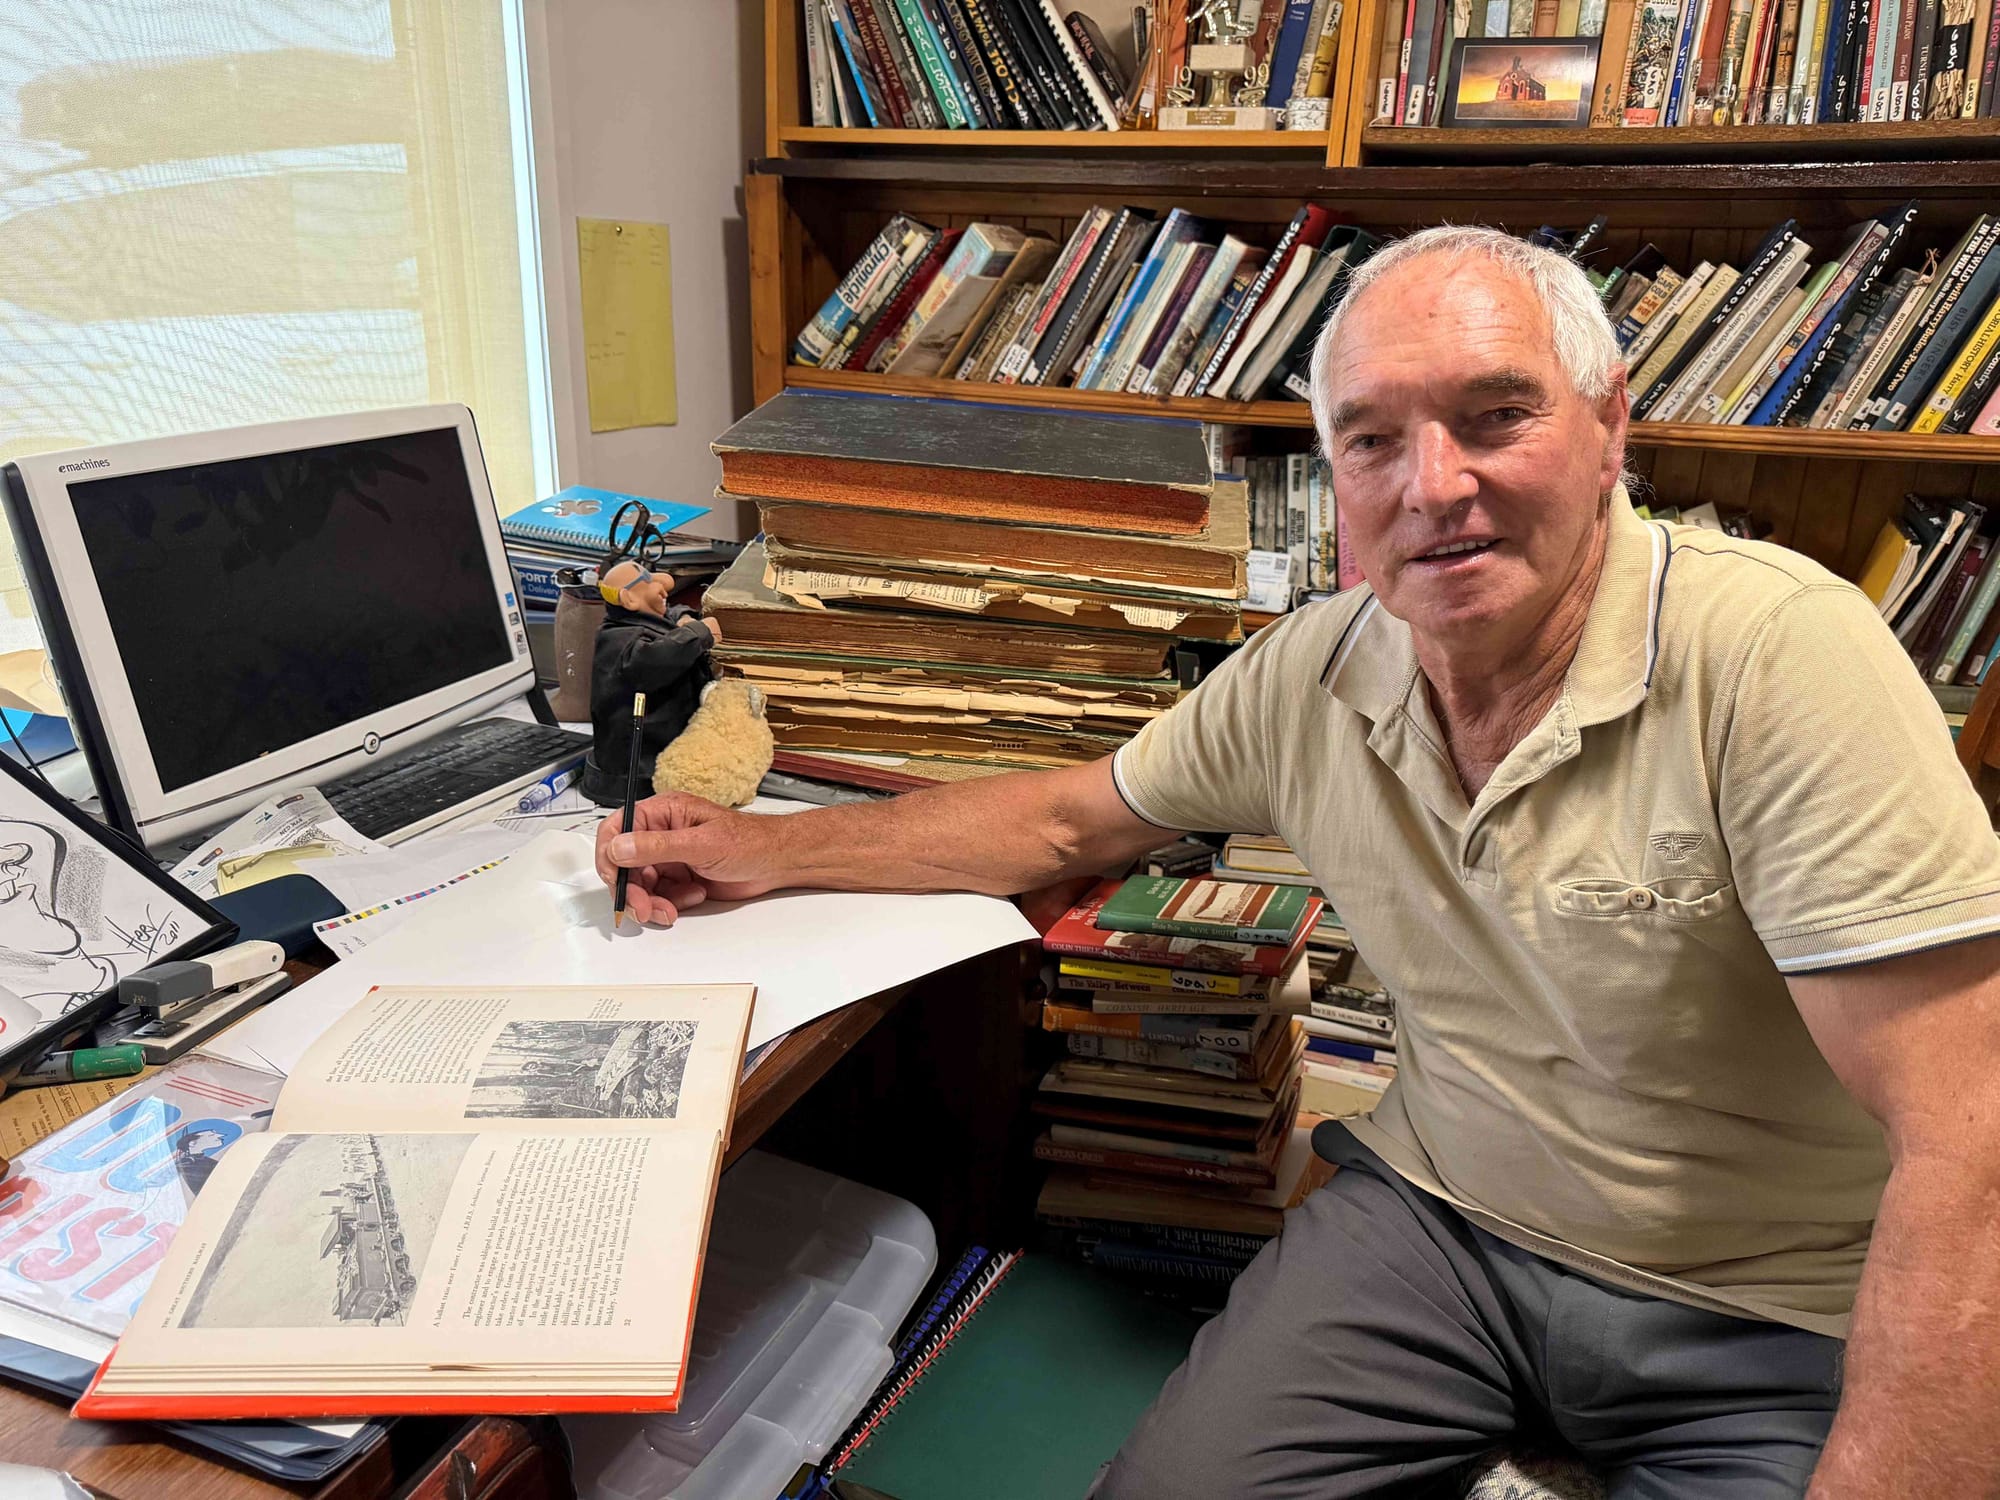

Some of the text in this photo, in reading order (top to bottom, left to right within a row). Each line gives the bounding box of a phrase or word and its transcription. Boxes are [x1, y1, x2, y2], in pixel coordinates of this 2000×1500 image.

[931, 9, 957, 60] INFO
[1946, 28, 1959, 69] 685
[868, 13, 901, 89] WANGARATTA
[1675, 46, 1688, 79] 672
[1918, 45, 1929, 79] TURNLEY
[988, 48, 1020, 104] CLOSE
[1835, 74, 1847, 116] 679
[1873, 90, 1884, 120] 682
[1893, 85, 1903, 117] 683
[1911, 82, 1922, 121] 684
[1965, 82, 1974, 112] 686
[1860, 209, 1918, 291] CAIRNS
[1977, 232, 1996, 260] THE
[843, 242, 890, 303] Chronicle
[1712, 231, 1793, 325] CAMPERDOWN
[1951, 252, 1972, 278] WILD
[1960, 255, 1983, 283] WILD
[1709, 272, 1732, 299] LALITA
[1950, 280, 1965, 299] with
[1933, 294, 1956, 326] Harry
[1708, 310, 1749, 355] Camperdown
[1912, 306, 1968, 383] BUSY FINGERS
[1845, 311, 1907, 402] BUYING AUSTRALIAN SHARES
[1887, 370, 1906, 392] Two
[1943, 372, 1964, 396] Harry
[58, 456, 111, 475] emachines
[528, 583, 561, 597] Delivery
[1051, 942, 1074, 951] COLIN
[1069, 979, 1151, 993] The Valley Between
[623, 1317, 632, 1326] 32
